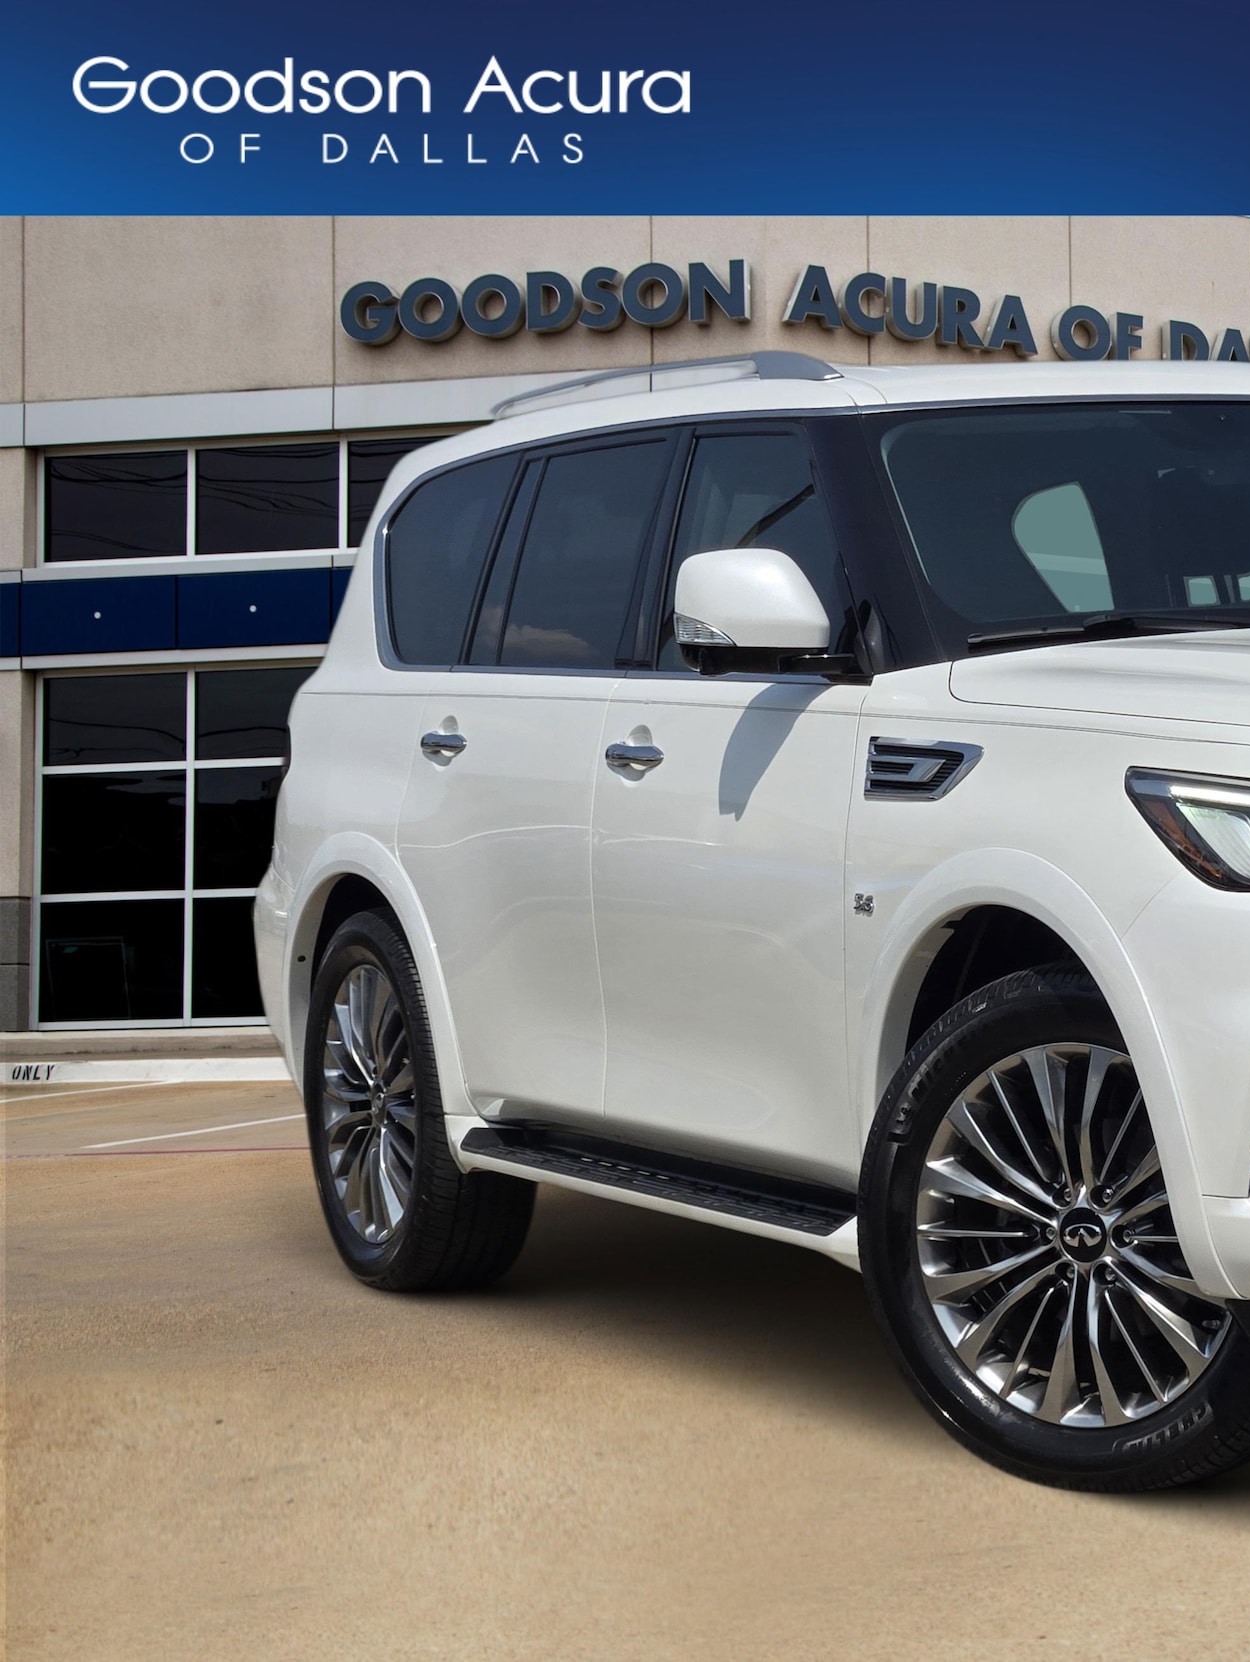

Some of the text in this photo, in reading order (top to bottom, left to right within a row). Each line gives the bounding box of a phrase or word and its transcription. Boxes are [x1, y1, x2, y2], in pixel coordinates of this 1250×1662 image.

[340, 258, 750, 345] GOODSON
[782, 263, 1038, 356] ACURA
[1051, 304, 1144, 361] OF
[12, 1064, 55, 1081] ONLY
